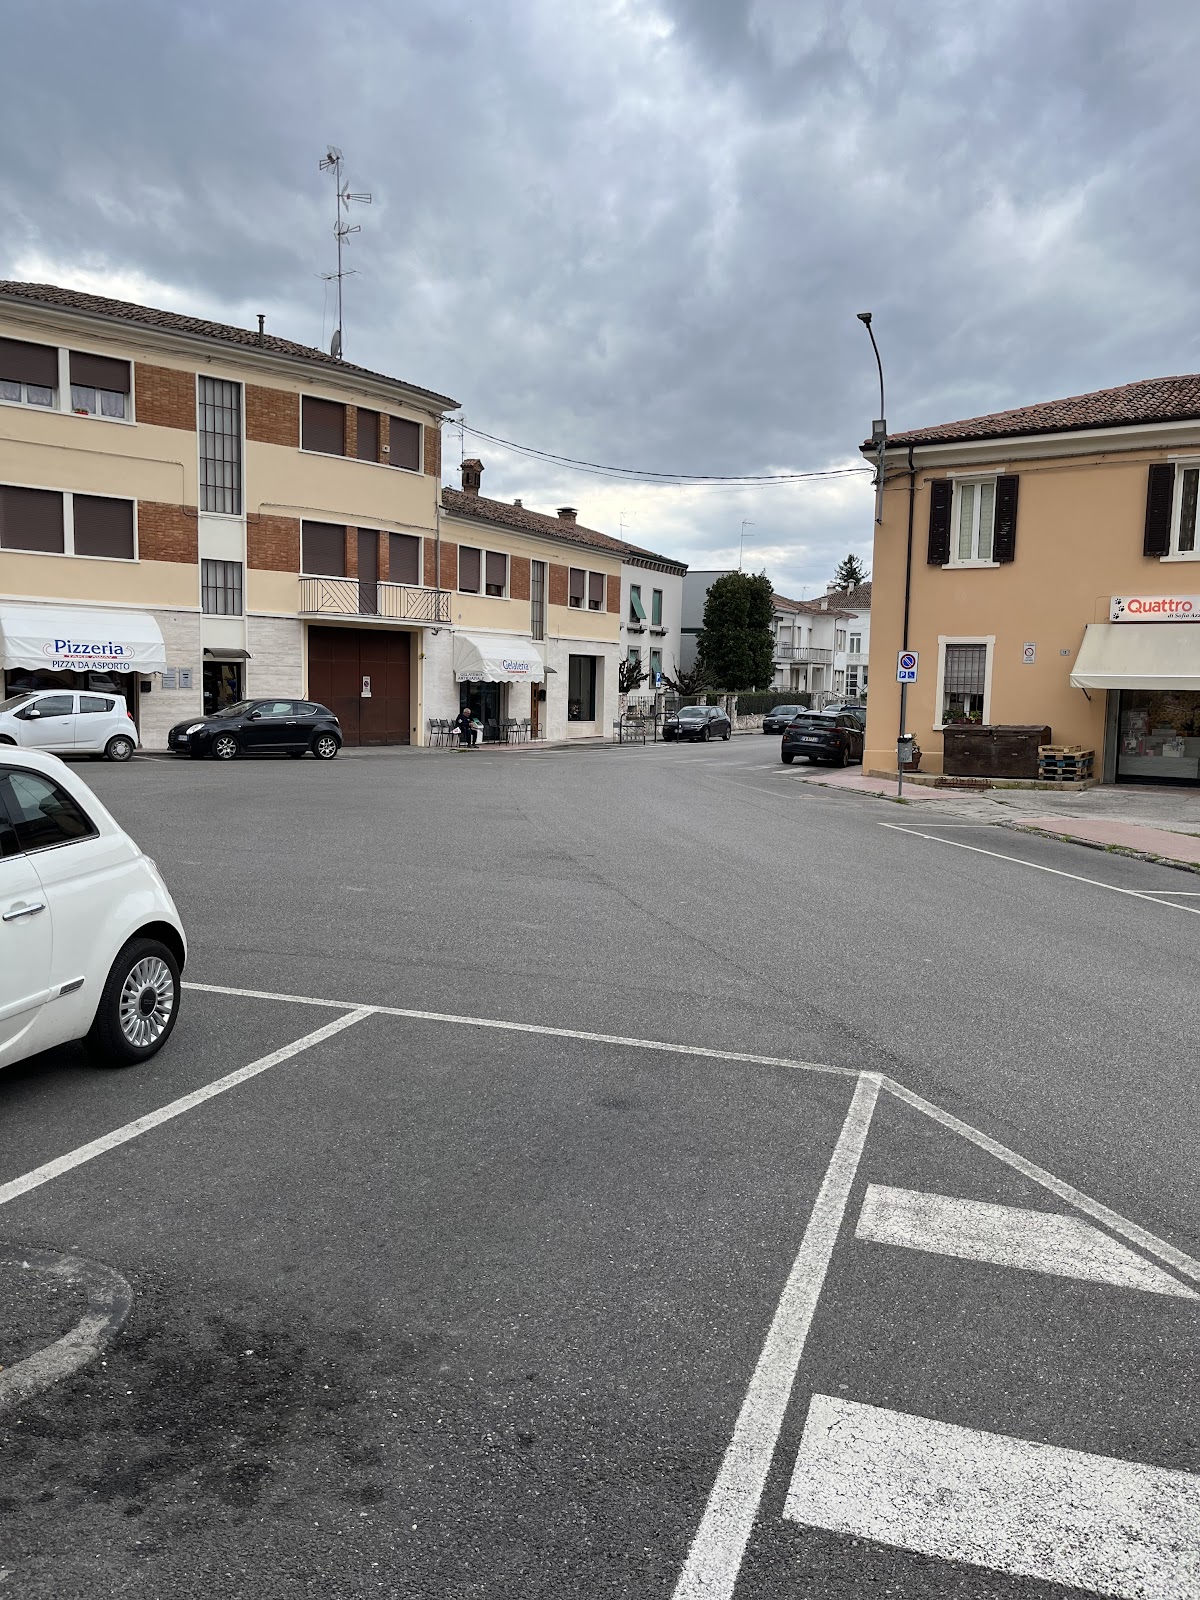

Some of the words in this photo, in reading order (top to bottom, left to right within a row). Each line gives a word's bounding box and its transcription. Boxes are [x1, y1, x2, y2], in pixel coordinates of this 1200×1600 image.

[1127, 599, 1193, 613] Quattro
[54, 639, 124, 655] Pizzeria
[52, 660, 76, 669] PIZZA
[78, 661, 90, 669] DA
[92, 662, 130, 670] ASPORTO
[502, 659, 530, 671] Gelateria
